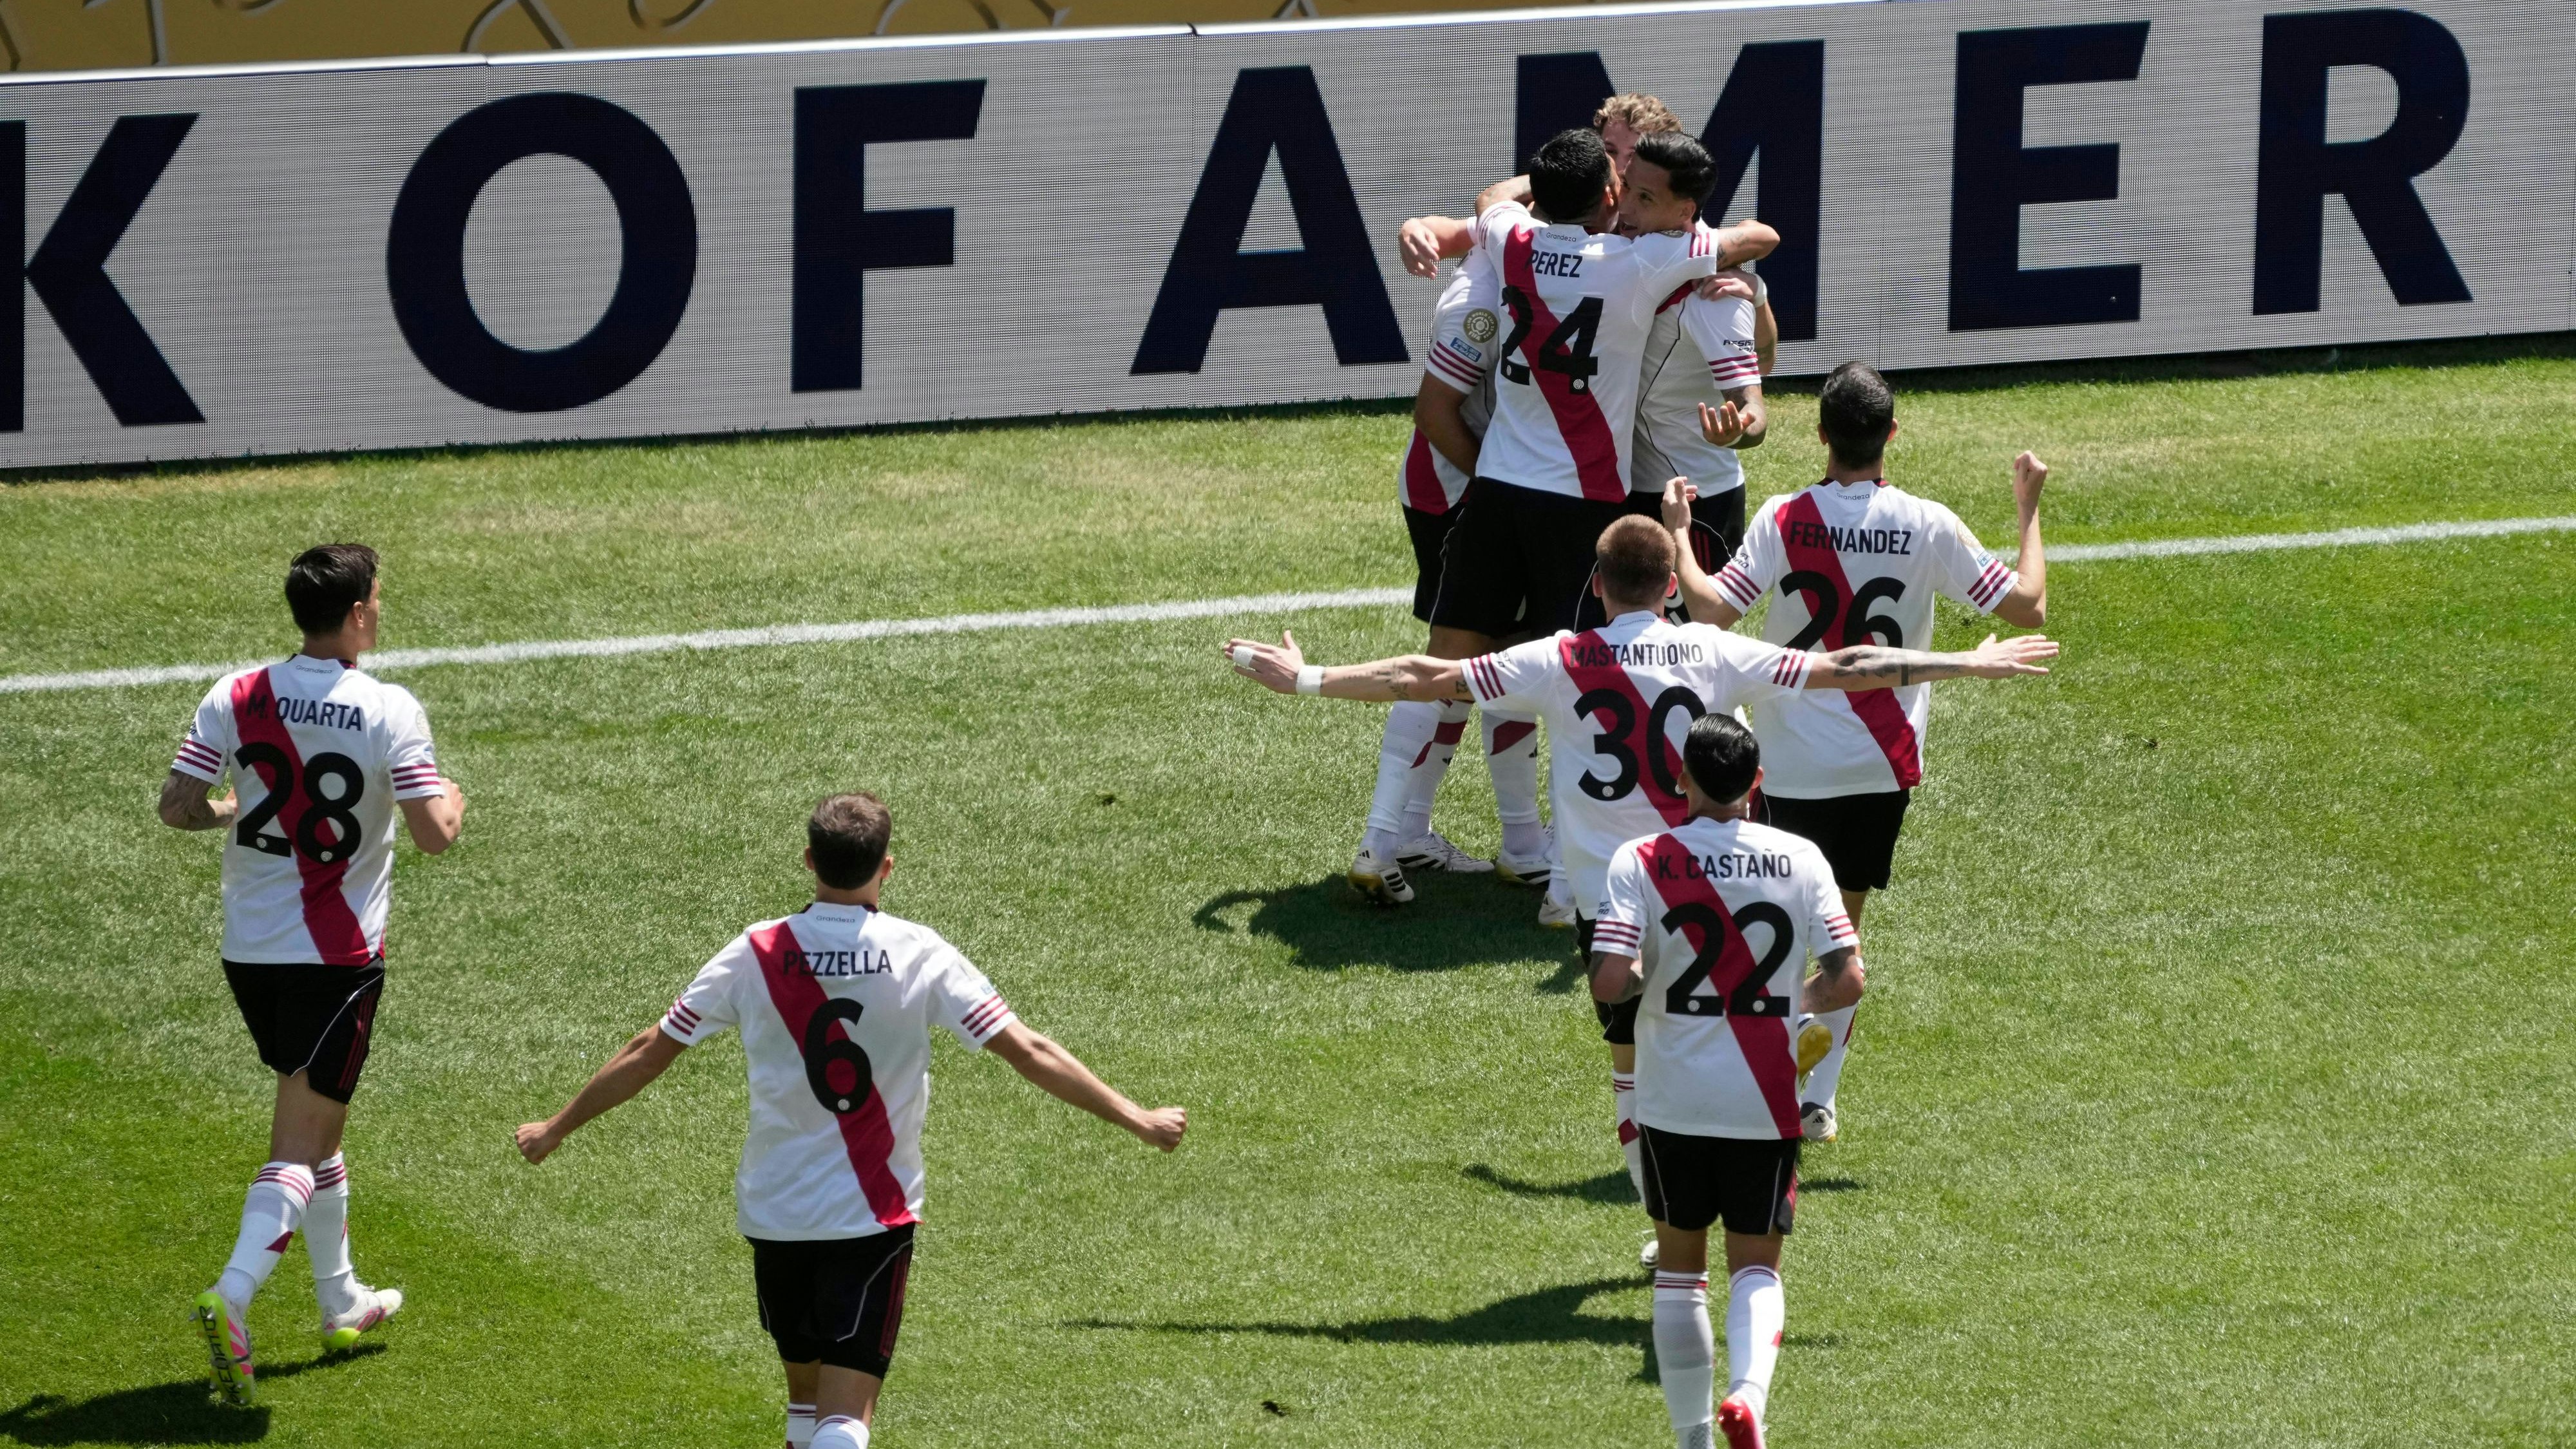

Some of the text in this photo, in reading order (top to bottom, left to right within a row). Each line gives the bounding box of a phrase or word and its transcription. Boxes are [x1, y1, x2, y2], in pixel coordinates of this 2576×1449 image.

[386, 79, 987, 413] OF
[1546, 232, 1577, 242] Grandeza
[1524, 249, 1583, 278] PEREZ
[1501, 285, 1604, 395] 24
[1790, 522, 1911, 555] FERNANDEZ
[1779, 570, 1906, 650] 26
[296, 665, 332, 674] Grandeza
[1570, 643, 1703, 668] MASTANTUONO
[247, 694, 363, 732] M. QUARTA
[1573, 685, 1707, 802] 30
[234, 742, 365, 865] 28
[1658, 848, 1792, 880] K. CASTAÑO
[783, 949, 893, 976] PEZZELLA
[1660, 902, 1794, 1018] 22
[804, 998, 872, 1114] 6
